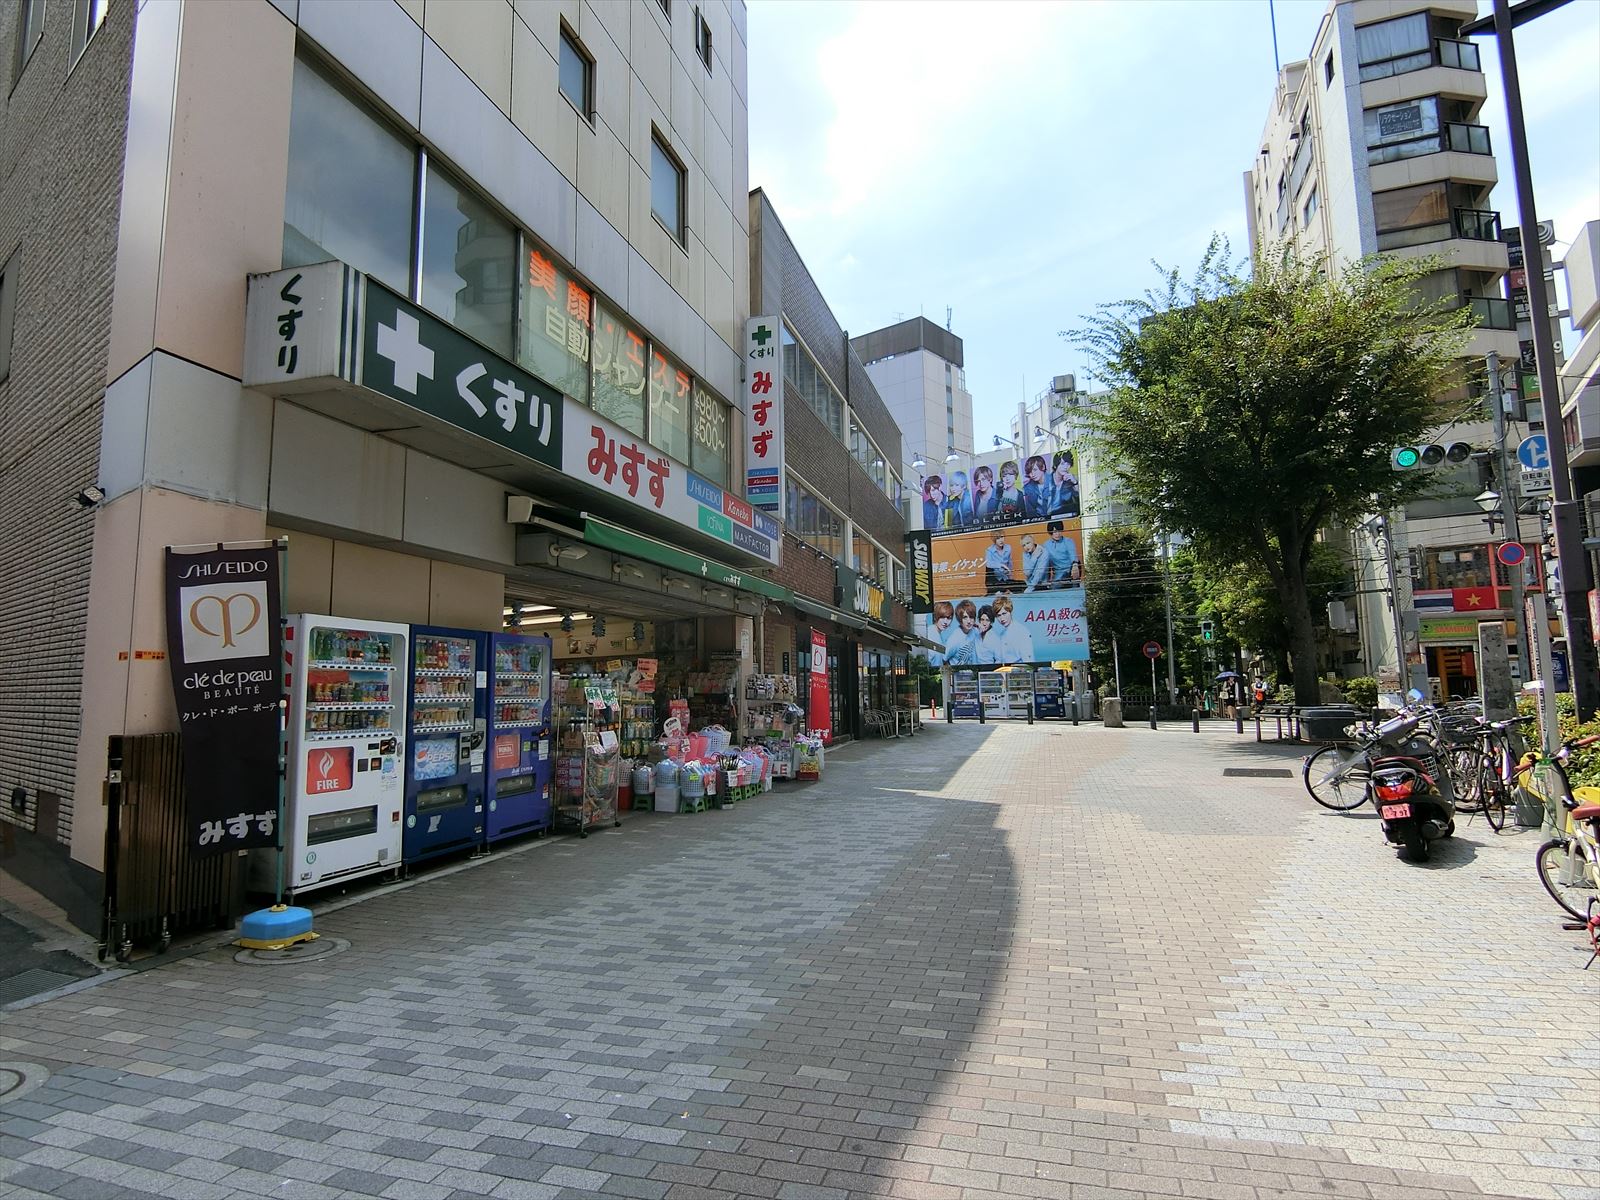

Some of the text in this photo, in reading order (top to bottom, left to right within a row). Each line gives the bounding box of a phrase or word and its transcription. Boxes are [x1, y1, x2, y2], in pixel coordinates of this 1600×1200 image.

[277, 273, 303, 374] くすり
[749, 349, 774, 358] くすり
[456, 362, 552, 447] くすり
[751, 370, 773, 458] みすず
[587, 425, 670, 509] みすず
[689, 480, 721, 506] SHISEIDO
[727, 499, 749, 522] Kanebo
[972, 511, 1022, 525] BLACK
[177, 560, 268, 579] SHISEIDO
[913, 538, 931, 605] SUBWAY
[854, 578, 885, 619] SUBWAY
[1024, 607, 1081, 622] AAA級の
[1046, 623, 1081, 637] 男たち
[183, 669, 273, 689] clé de peau
[204, 683, 260, 700] BEAUTÉ
[427, 752, 455, 760] PEPSI
[771, 763, 788, 775] LE
[316, 778, 339, 791] FIRE
[199, 809, 277, 846] みすず
